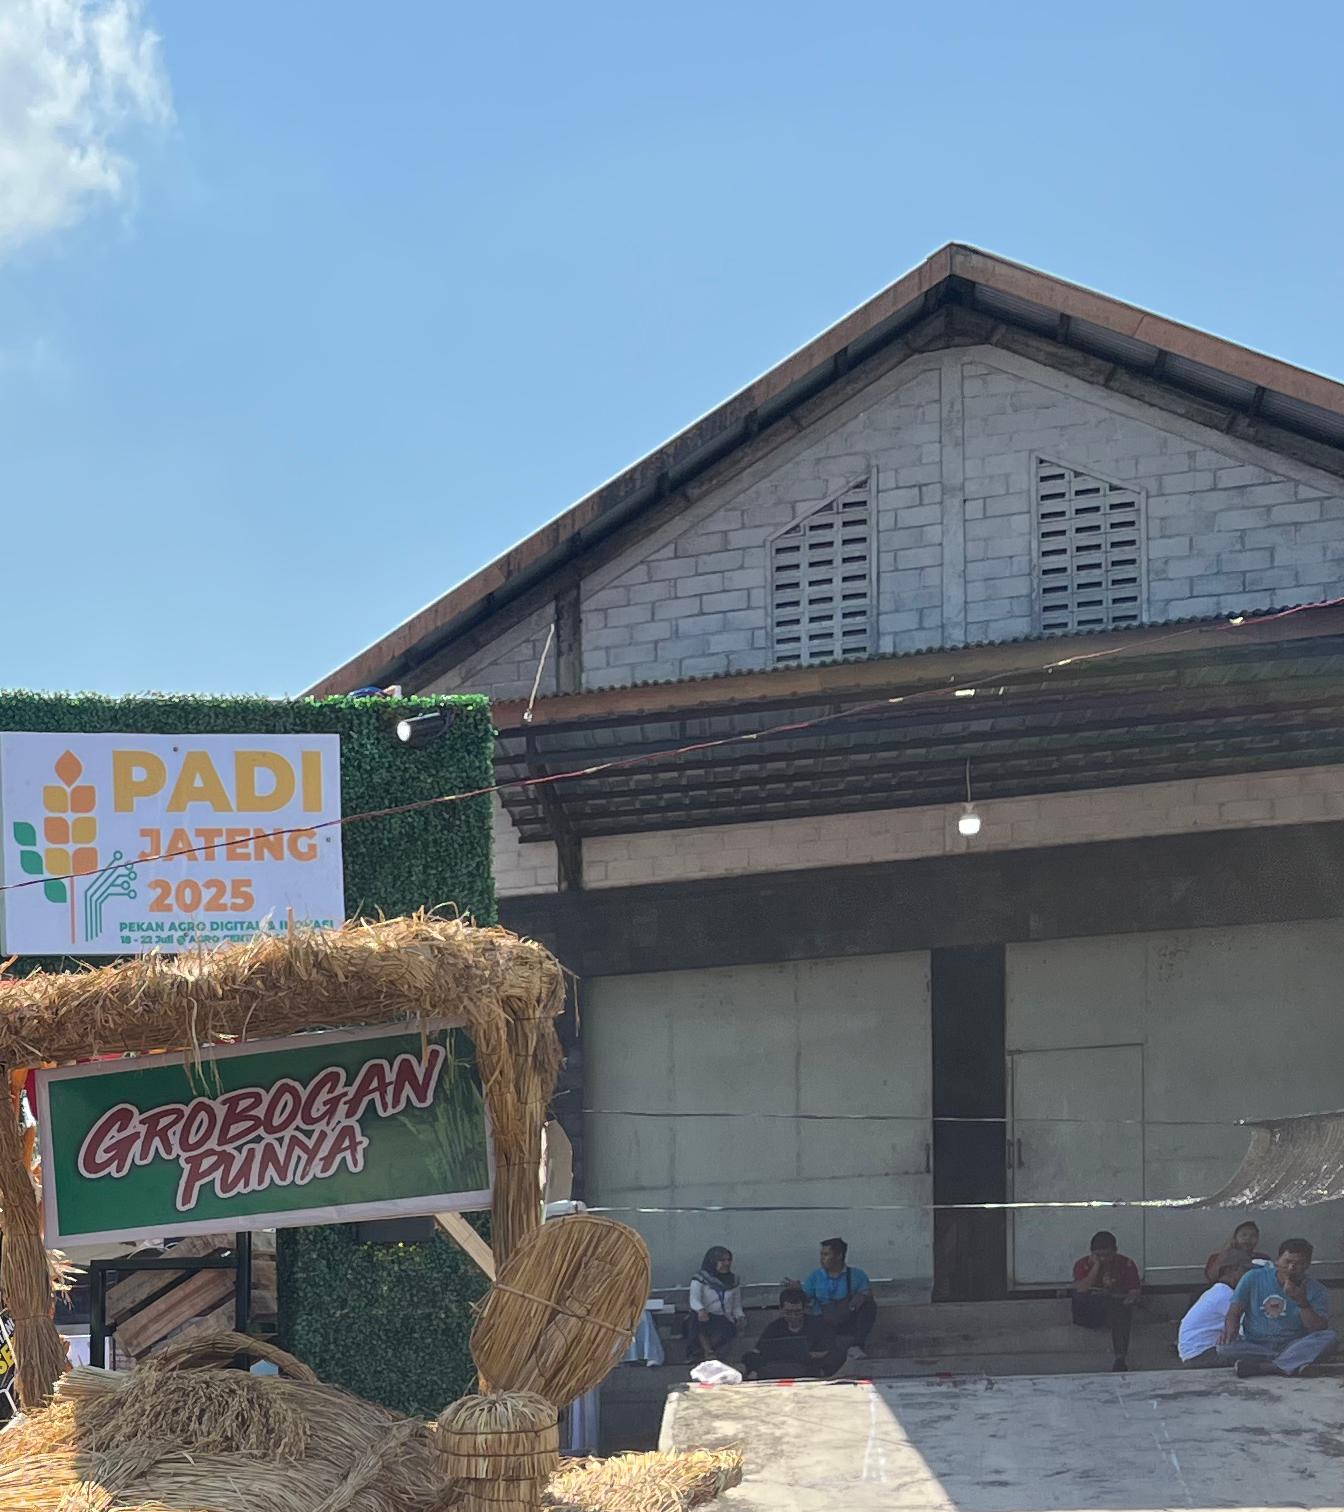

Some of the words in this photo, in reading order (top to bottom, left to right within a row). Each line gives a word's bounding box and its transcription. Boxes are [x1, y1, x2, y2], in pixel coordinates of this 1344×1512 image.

[112, 750, 322, 813] PADI
[137, 828, 318, 862] JATENG
[148, 879, 255, 913] 2025
[119, 921, 165, 933] PEKAN
[168, 921, 206, 932] AGRO
[81, 1047, 442, 1176] GROBOGAN
[179, 1124, 364, 1208] PUNYA
